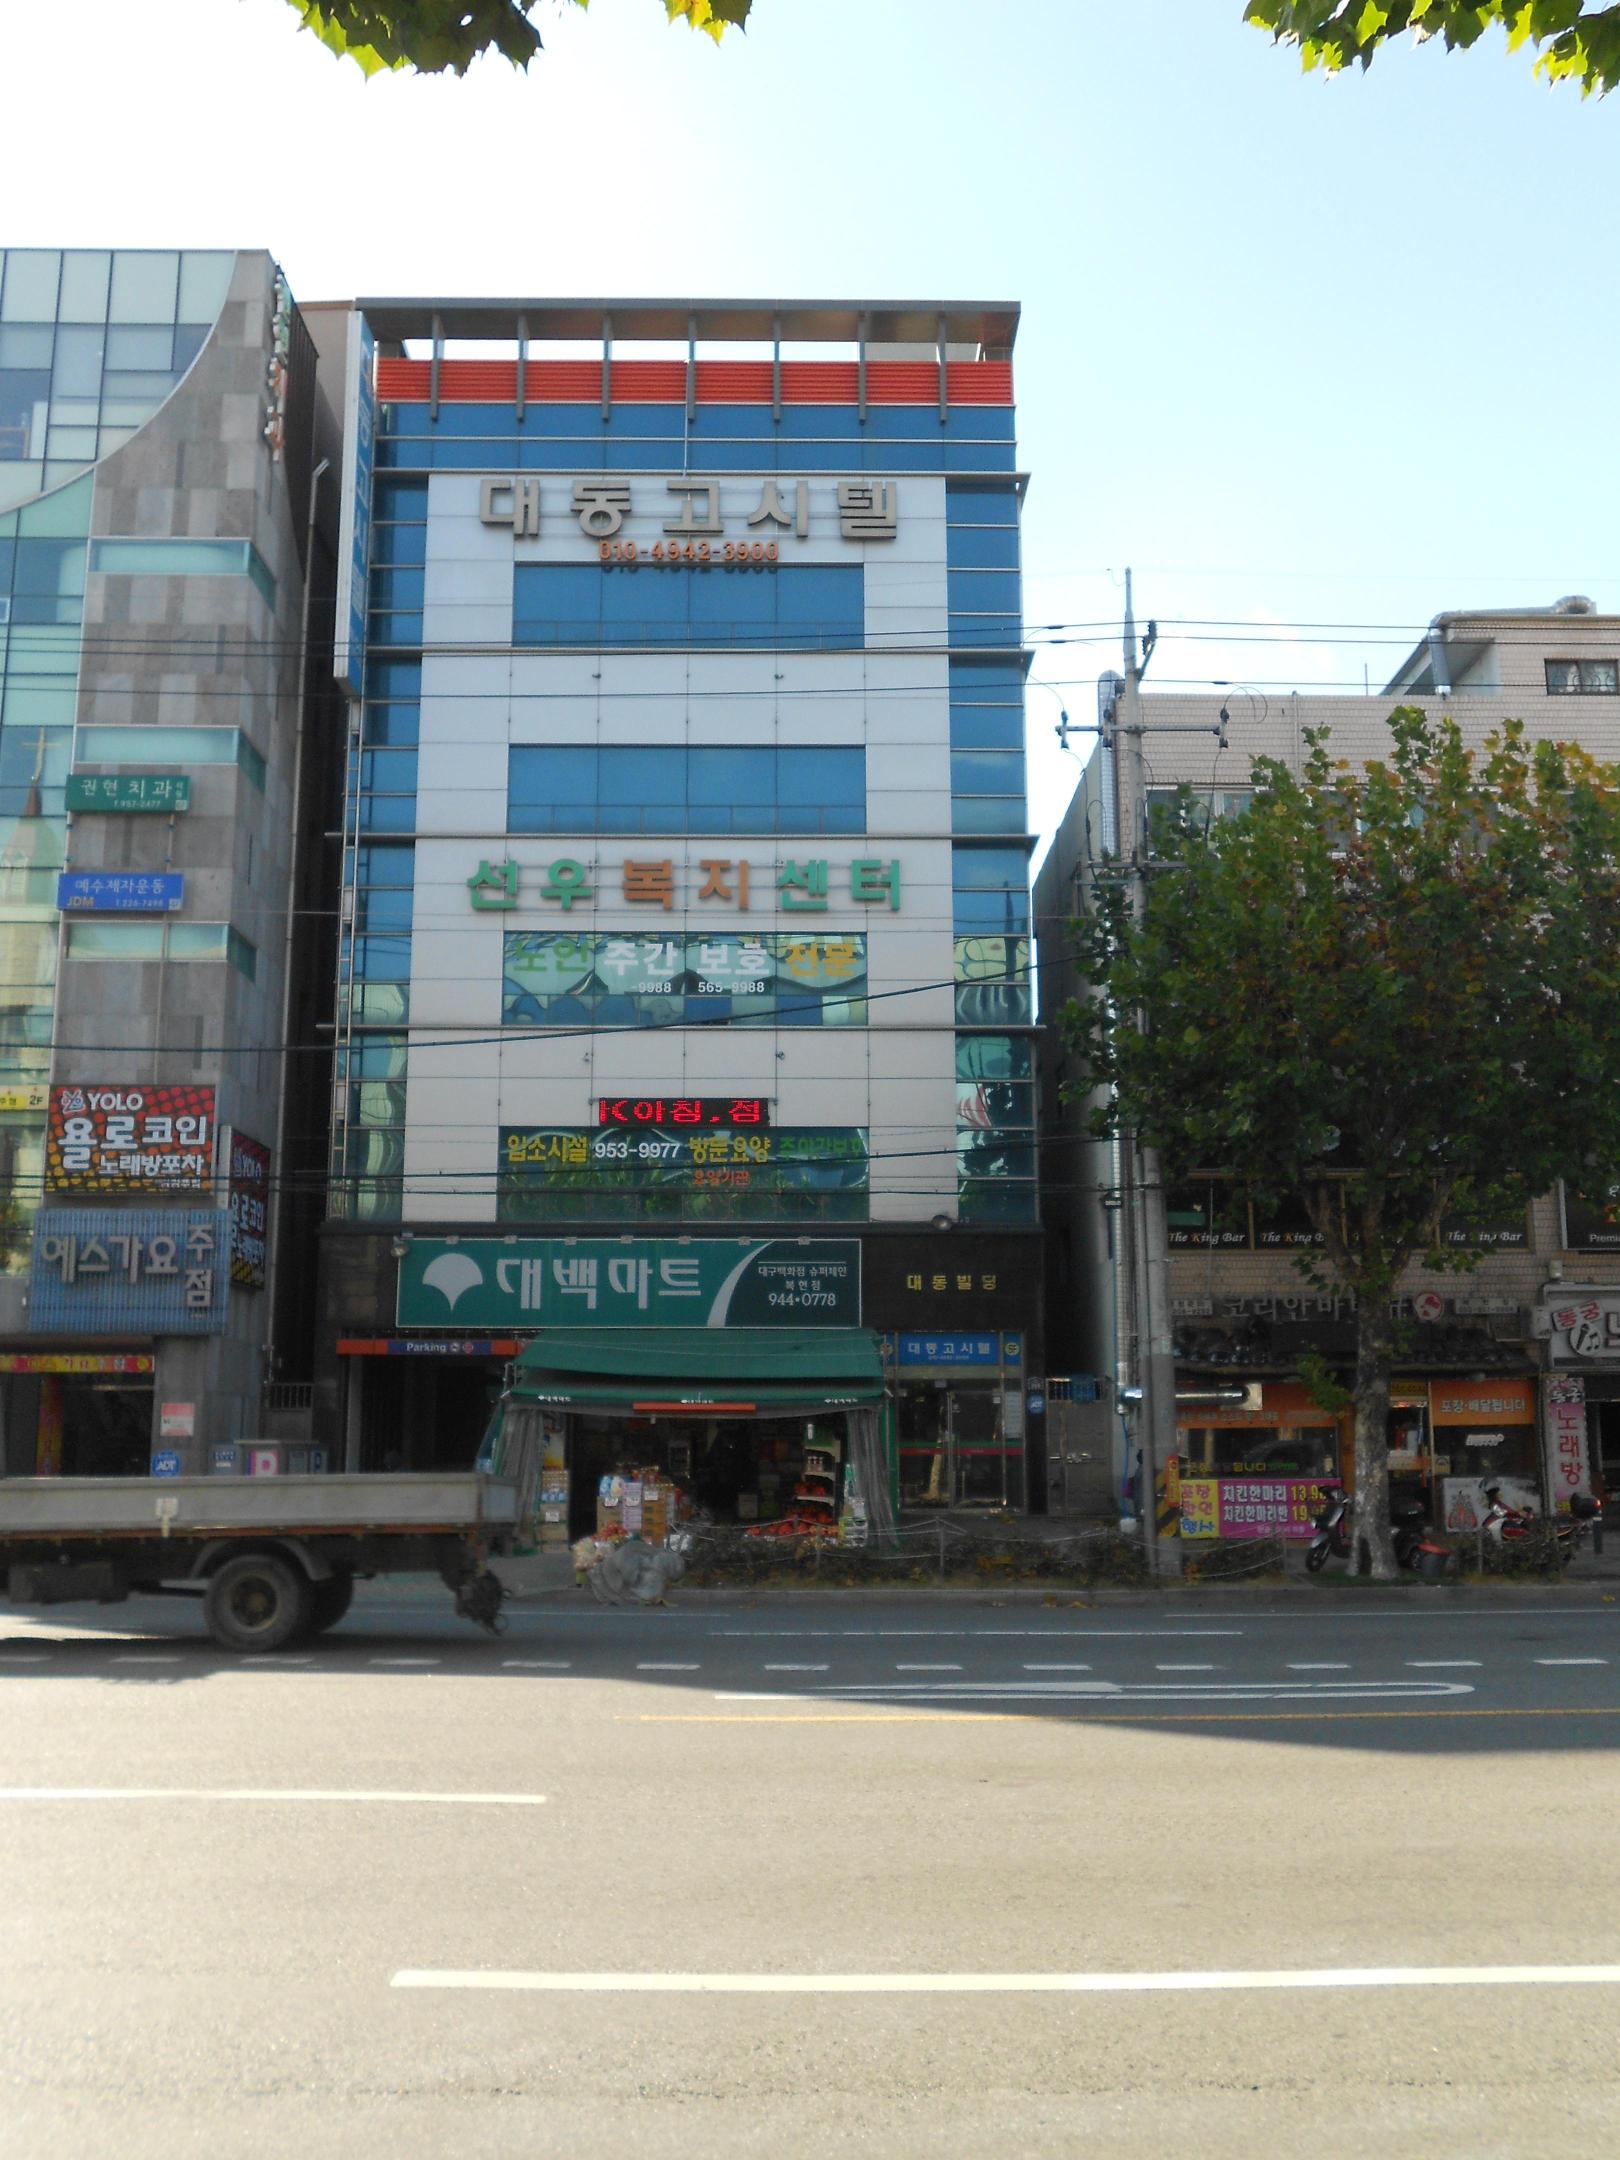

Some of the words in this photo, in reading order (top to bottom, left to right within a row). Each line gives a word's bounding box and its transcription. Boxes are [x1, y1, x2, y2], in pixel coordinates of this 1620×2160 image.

[479, 479, 897, 538] 대동고시텔
[598, 540, 779, 561] 010-4942-3900
[603, 941, 675, 976] 주간
[697, 943, 770, 975] 보호
[784, 942, 857, 977] 전문
[697, 981, 765, 993] 565-9988
[87, 1093, 143, 1111] YOLO
[57, 1115, 207, 1169] 욜로코인
[506, 1134, 587, 1163] 입소시설
[594, 1143, 680, 1159] 953-9977
[688, 1135, 771, 1164] 방문요양
[98, 1154, 204, 1176] 노래방포차
[1191, 1232, 1220, 1245] King
[1222, 1232, 1245, 1242] Bar
[1500, 1231, 1523, 1241] Bar
[40, 1235, 179, 1283] 예스가요
[186, 1223, 214, 1307] 주점
[496, 1258, 701, 1310] 대백마트
[906, 1273, 998, 1291] 대동빌딩
[406, 1342, 447, 1353] Parking
[908, 1342, 990, 1355] 대동고시텔
[1557, 1408, 1584, 1486] 노래방
[1223, 1485, 1287, 1503] 치킨한마리
